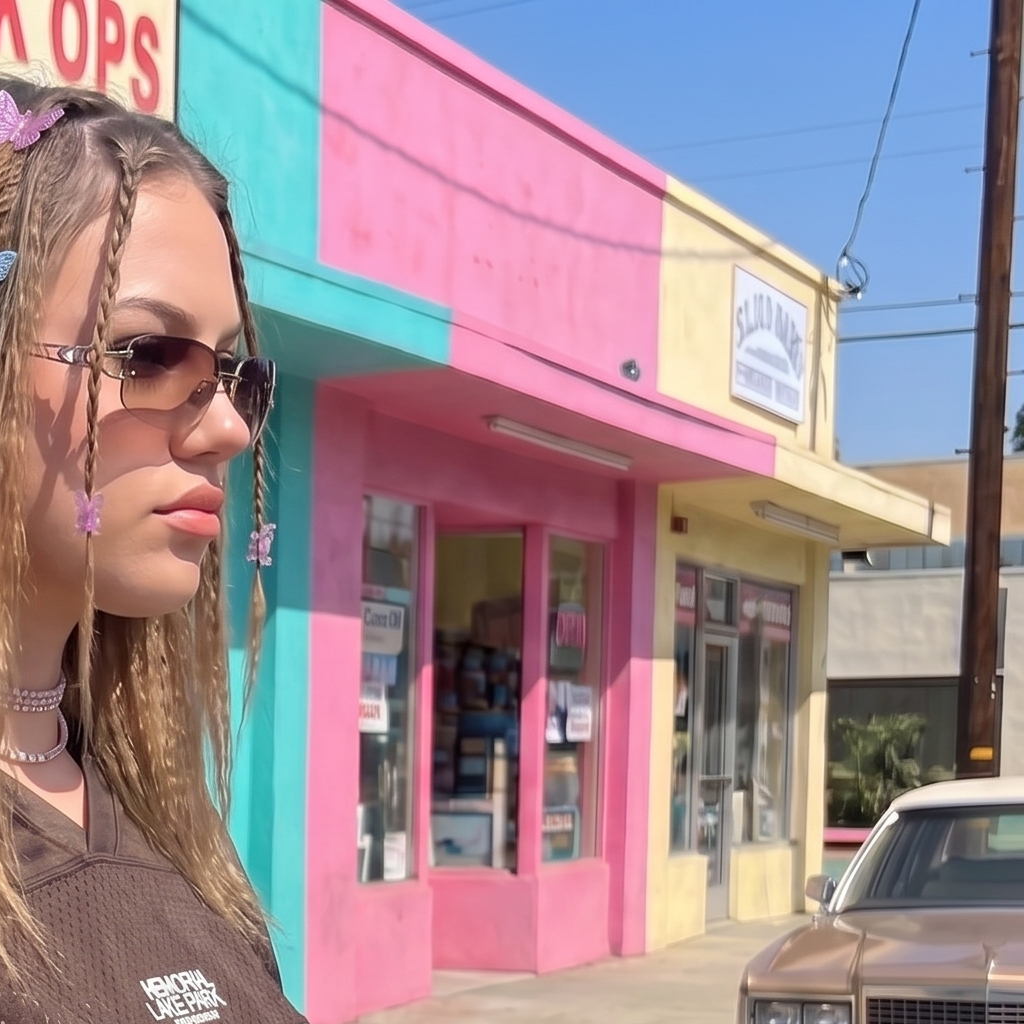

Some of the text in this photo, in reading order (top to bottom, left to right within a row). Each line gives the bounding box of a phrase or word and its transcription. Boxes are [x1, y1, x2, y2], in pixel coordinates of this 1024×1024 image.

[51, 0, 160, 113] OPS
[145, 995, 190, 1020] LAKE
[182, 987, 227, 1013] PARK
